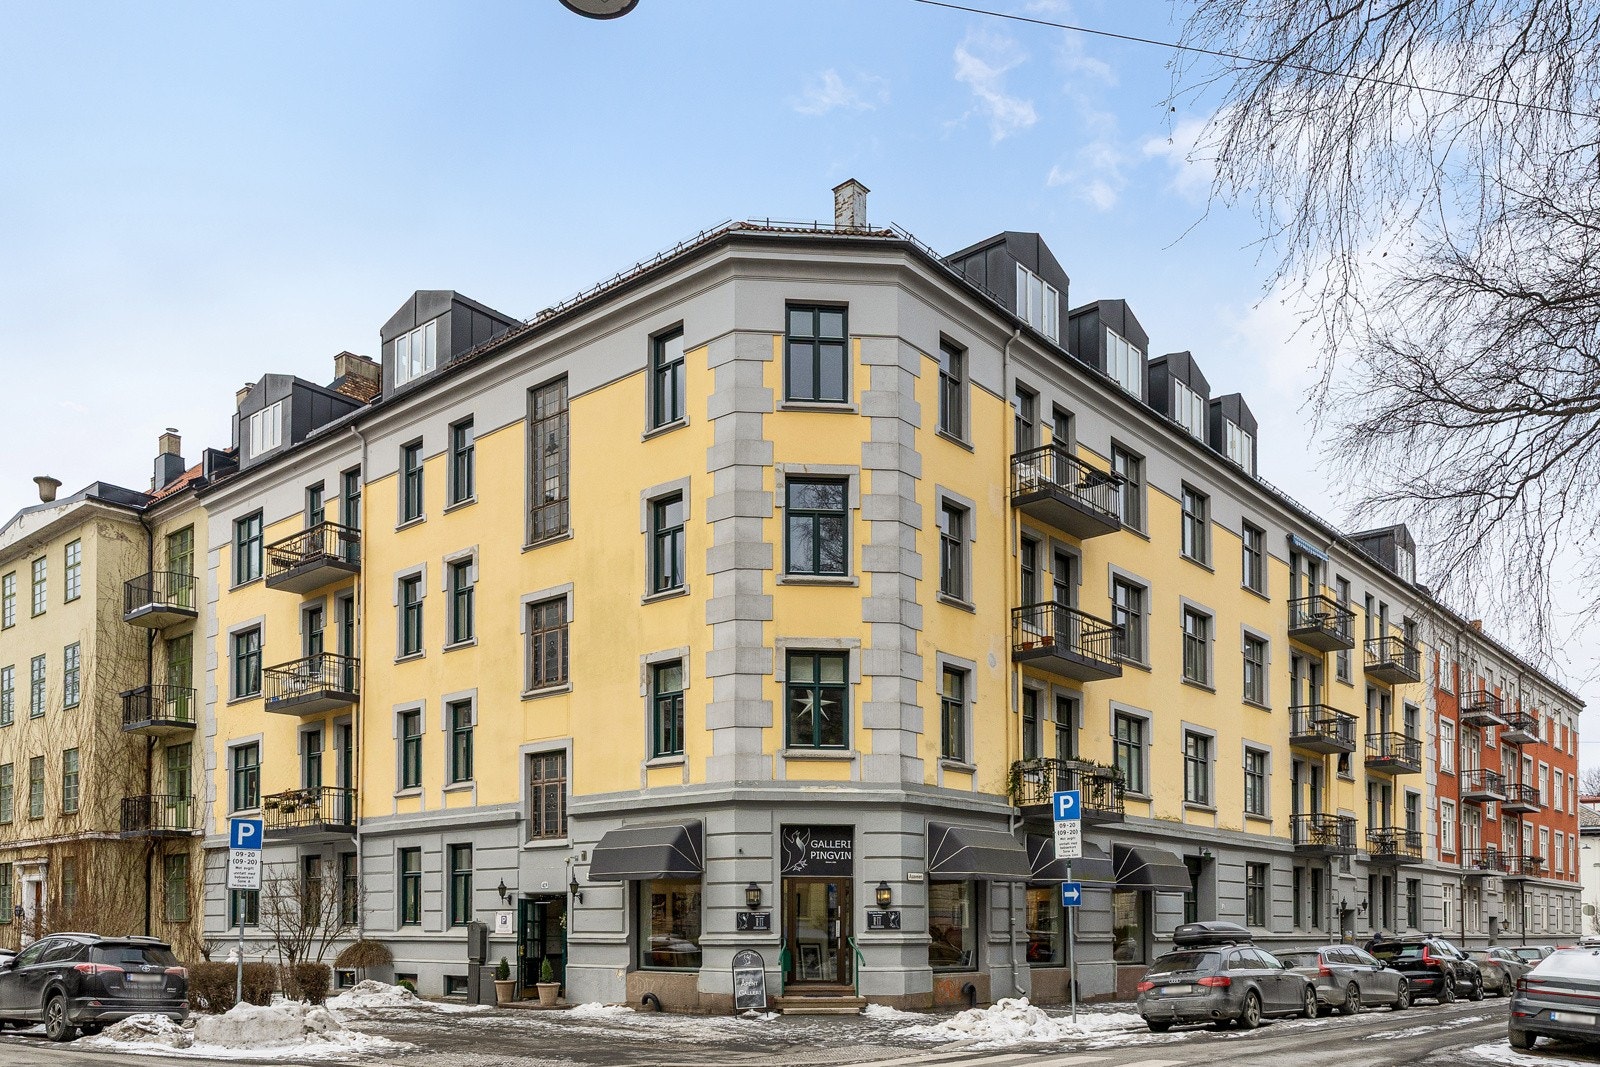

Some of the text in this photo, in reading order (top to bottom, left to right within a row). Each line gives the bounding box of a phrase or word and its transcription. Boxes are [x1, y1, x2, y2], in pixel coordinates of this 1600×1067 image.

[1060, 795, 1074, 817] P
[238, 822, 255, 845] P
[810, 839, 851, 848] GALLERI
[810, 851, 852, 860] PINGVIN
